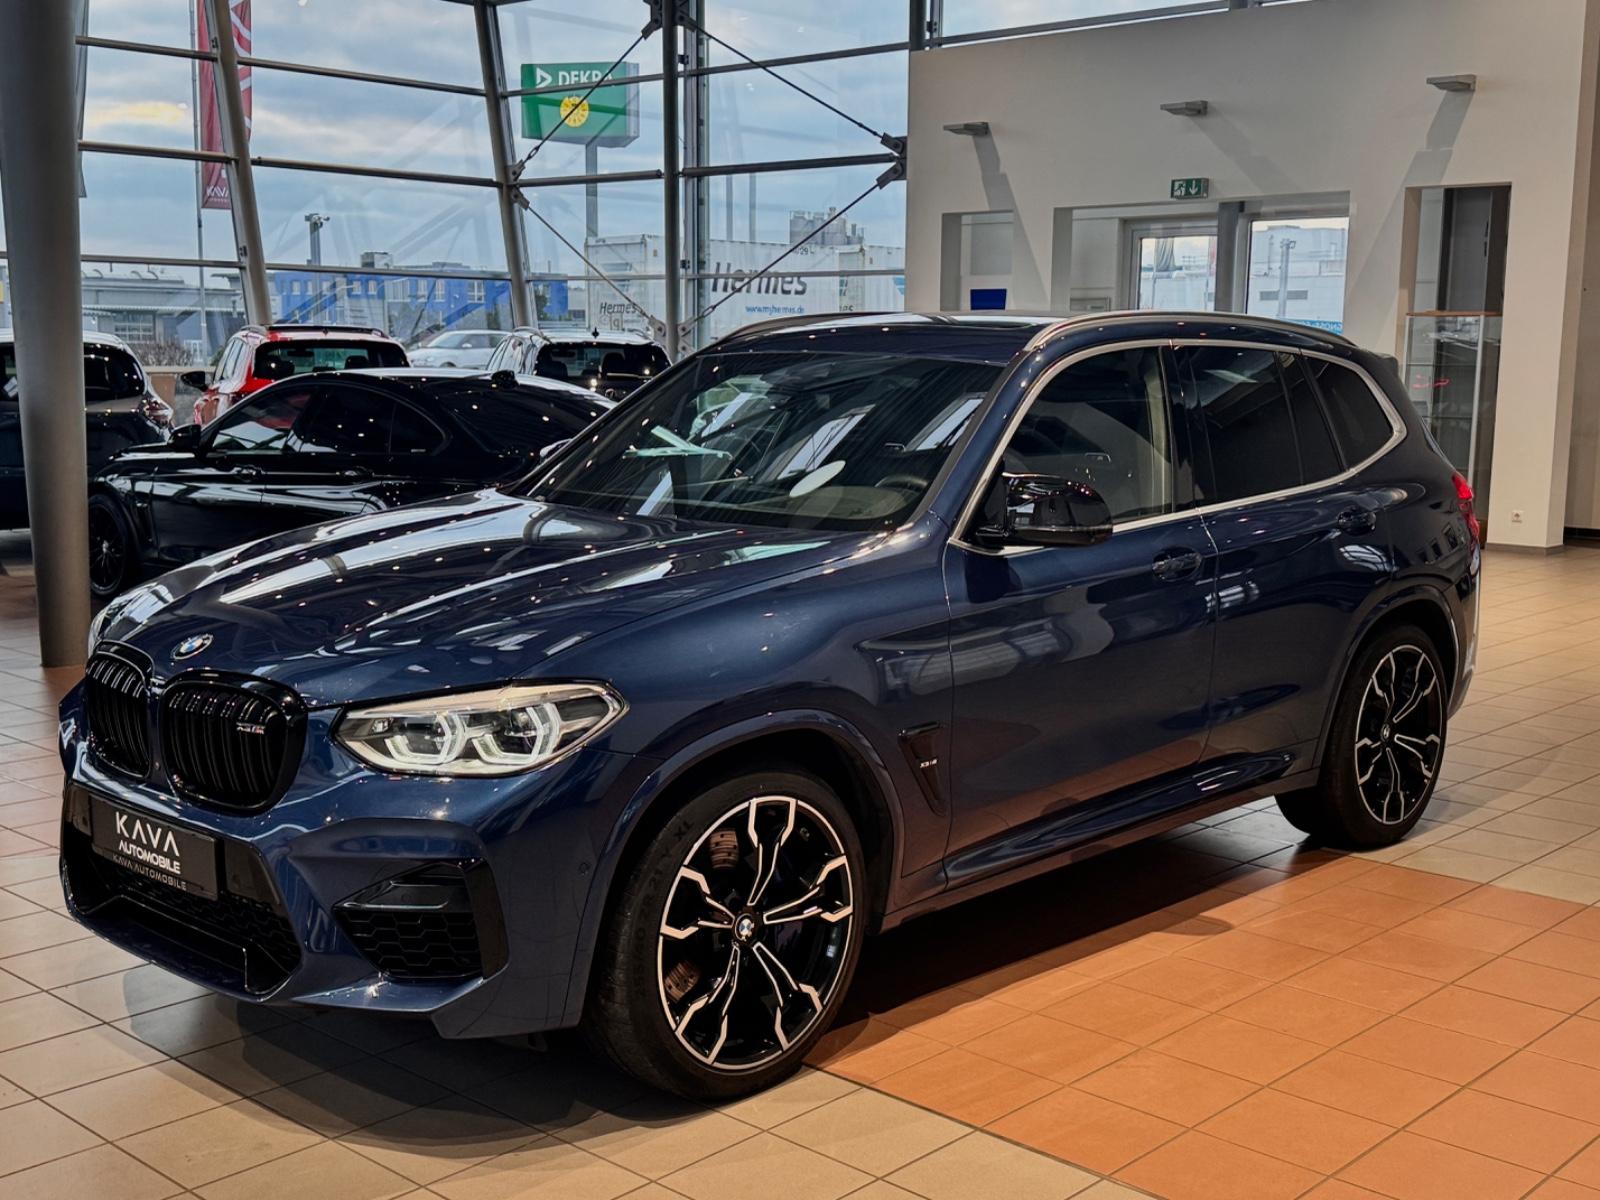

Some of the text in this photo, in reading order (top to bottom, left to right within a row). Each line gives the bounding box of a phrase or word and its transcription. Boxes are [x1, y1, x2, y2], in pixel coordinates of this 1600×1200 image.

[558, 70, 615, 87] DEKR
[711, 261, 808, 296] Hermes
[599, 302, 638, 315] Hermes
[115, 811, 180, 857] KAVA
[112, 854, 187, 892] KAVA AUTOMOBILE
[118, 839, 181, 875] AUTOMOBILE
